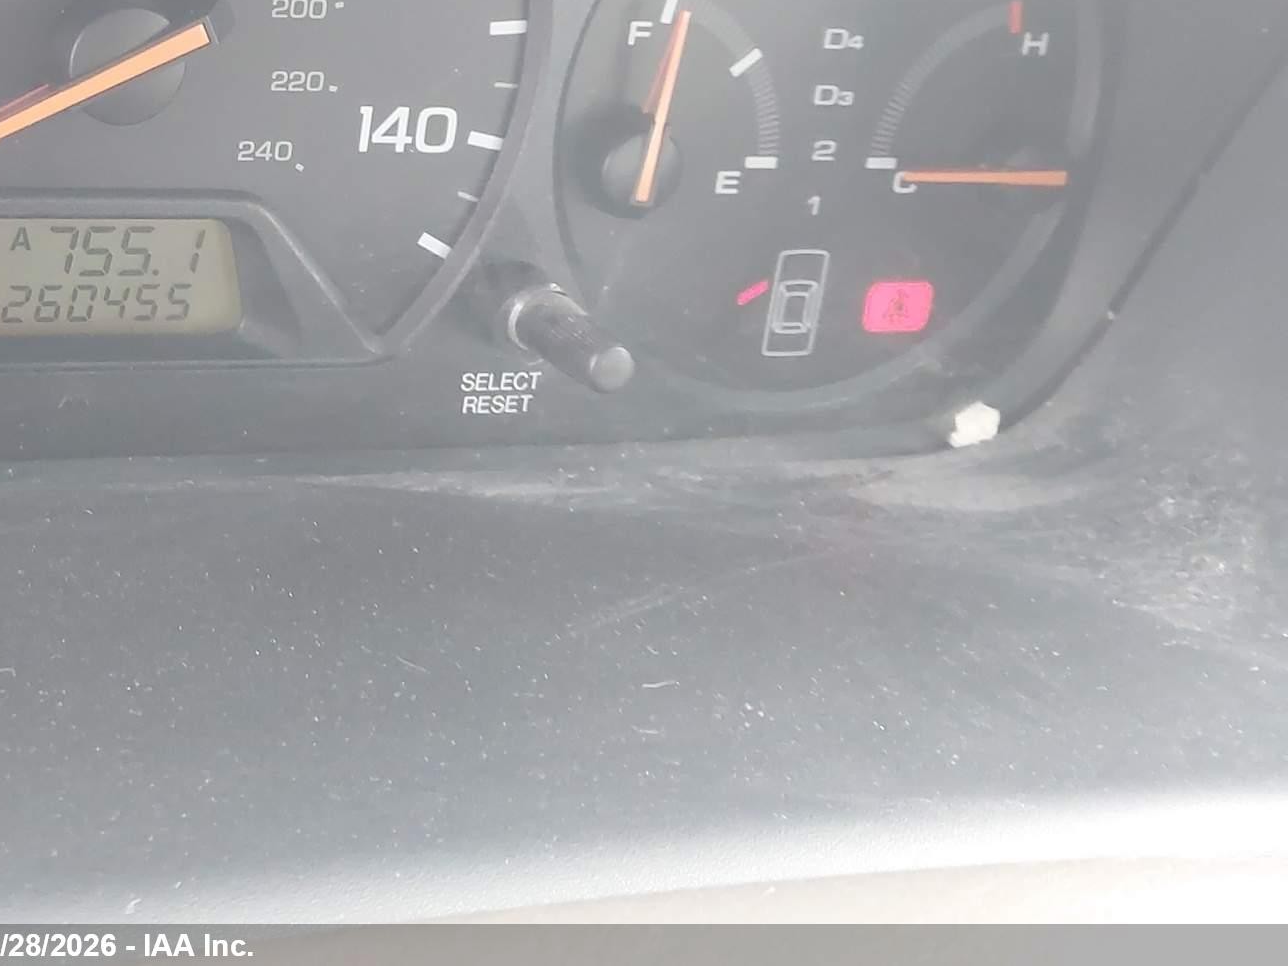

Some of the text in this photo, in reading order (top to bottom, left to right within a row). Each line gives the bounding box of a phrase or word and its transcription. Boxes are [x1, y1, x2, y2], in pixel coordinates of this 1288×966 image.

[627, 22, 652, 45] F
[1021, 33, 1049, 56] H
[270, 71, 325, 92] 220
[358, 106, 458, 154] 140
[237, 141, 292, 162] 240
[812, 141, 837, 162] 2
[715, 172, 742, 195] E
[807, 197, 821, 215] 1
[10, 226, 31, 251] A
[1, 284, 192, 324] 260455
[461, 372, 541, 391] SELECT
[462, 395, 533, 414] RESET
